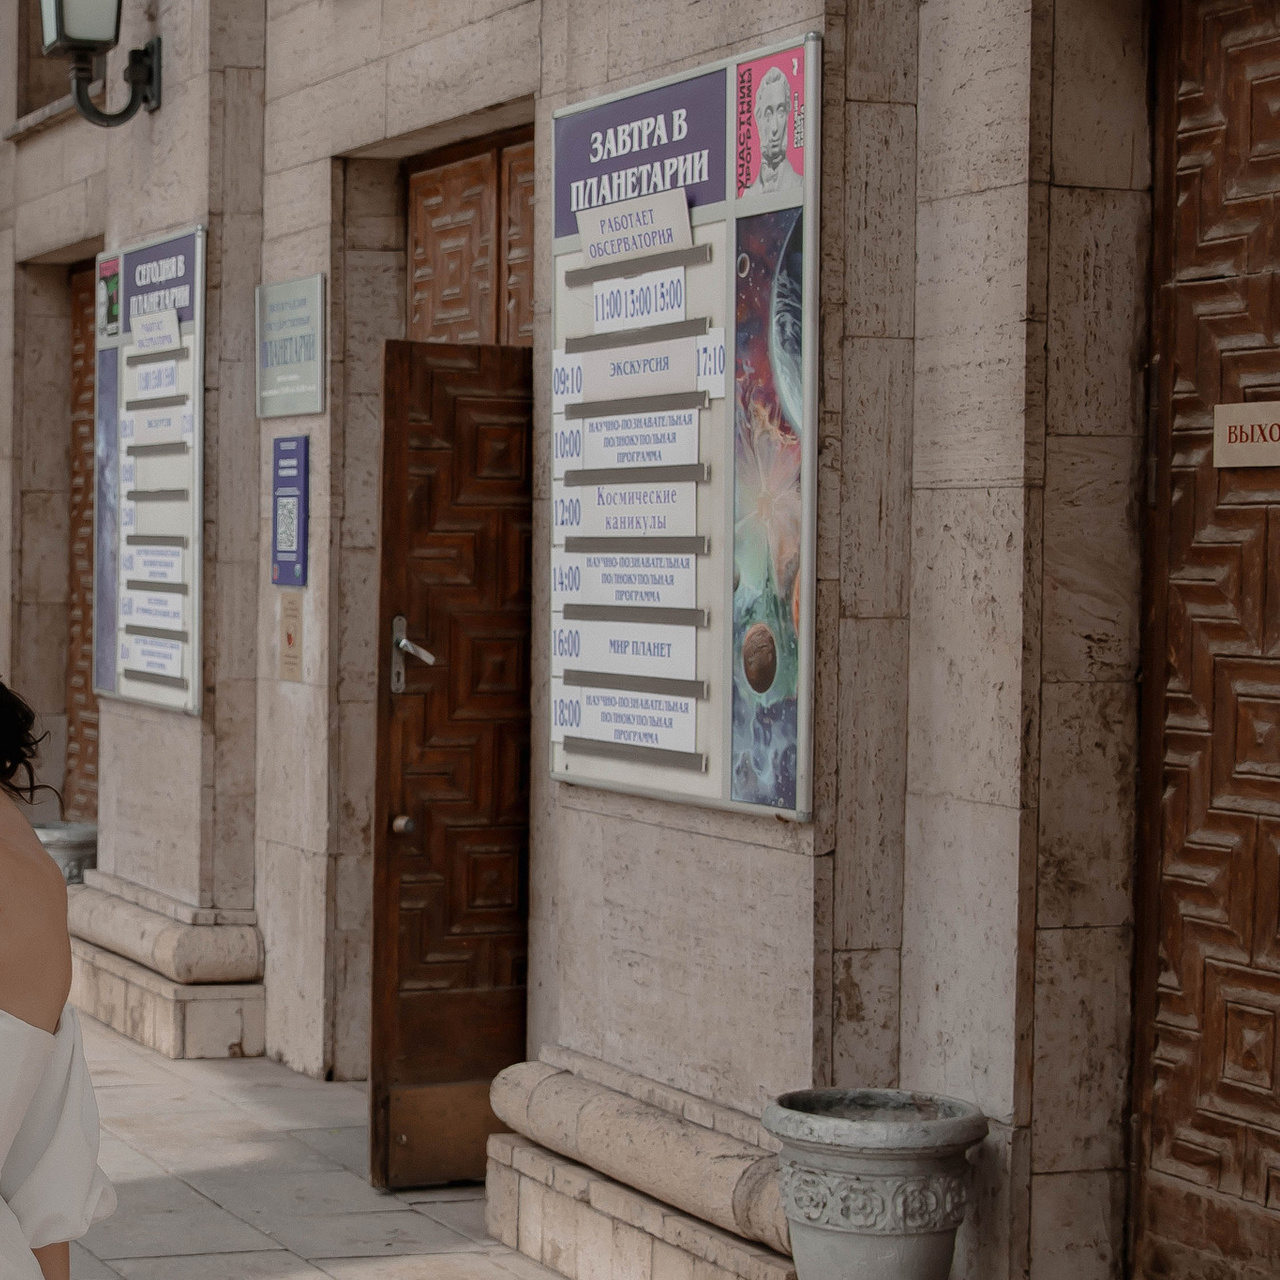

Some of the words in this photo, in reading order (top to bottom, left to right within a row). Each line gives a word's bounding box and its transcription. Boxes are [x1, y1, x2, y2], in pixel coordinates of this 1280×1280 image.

[589, 113, 668, 164] ЗАВТРА
[672, 108, 688, 142] В
[737, 71, 747, 190] УЧАСТНИК
[570, 149, 710, 212] ПЛАНЕТАРИИ
[600, 209, 654, 235] РАБОТАЕТ
[589, 228, 674, 259] ОБСЕРВАТОРИЯ
[595, 289, 622, 322] 11:00
[654, 278, 682, 313] 15:00
[553, 365, 583, 395] 09:10
[610, 356, 670, 377] ЭКСКУРСИЯ
[696, 345, 726, 377] 17:10
[554, 429, 581, 459] 10:00
[616, 450, 662, 464] ПРОГРАММА
[597, 487, 677, 506] Космические
[554, 498, 581, 527] 12:00
[605, 515, 667, 536] каникулы
[553, 566, 581, 592] 14:00
[615, 590, 661, 602] ПРОГРАММА
[553, 629, 581, 658] 16:00
[609, 639, 630, 656] МИР
[631, 641, 672, 658] ПЛАНЕТ
[553, 699, 581, 728] 18:00
[614, 729, 659, 744] ПРОГРАММА
